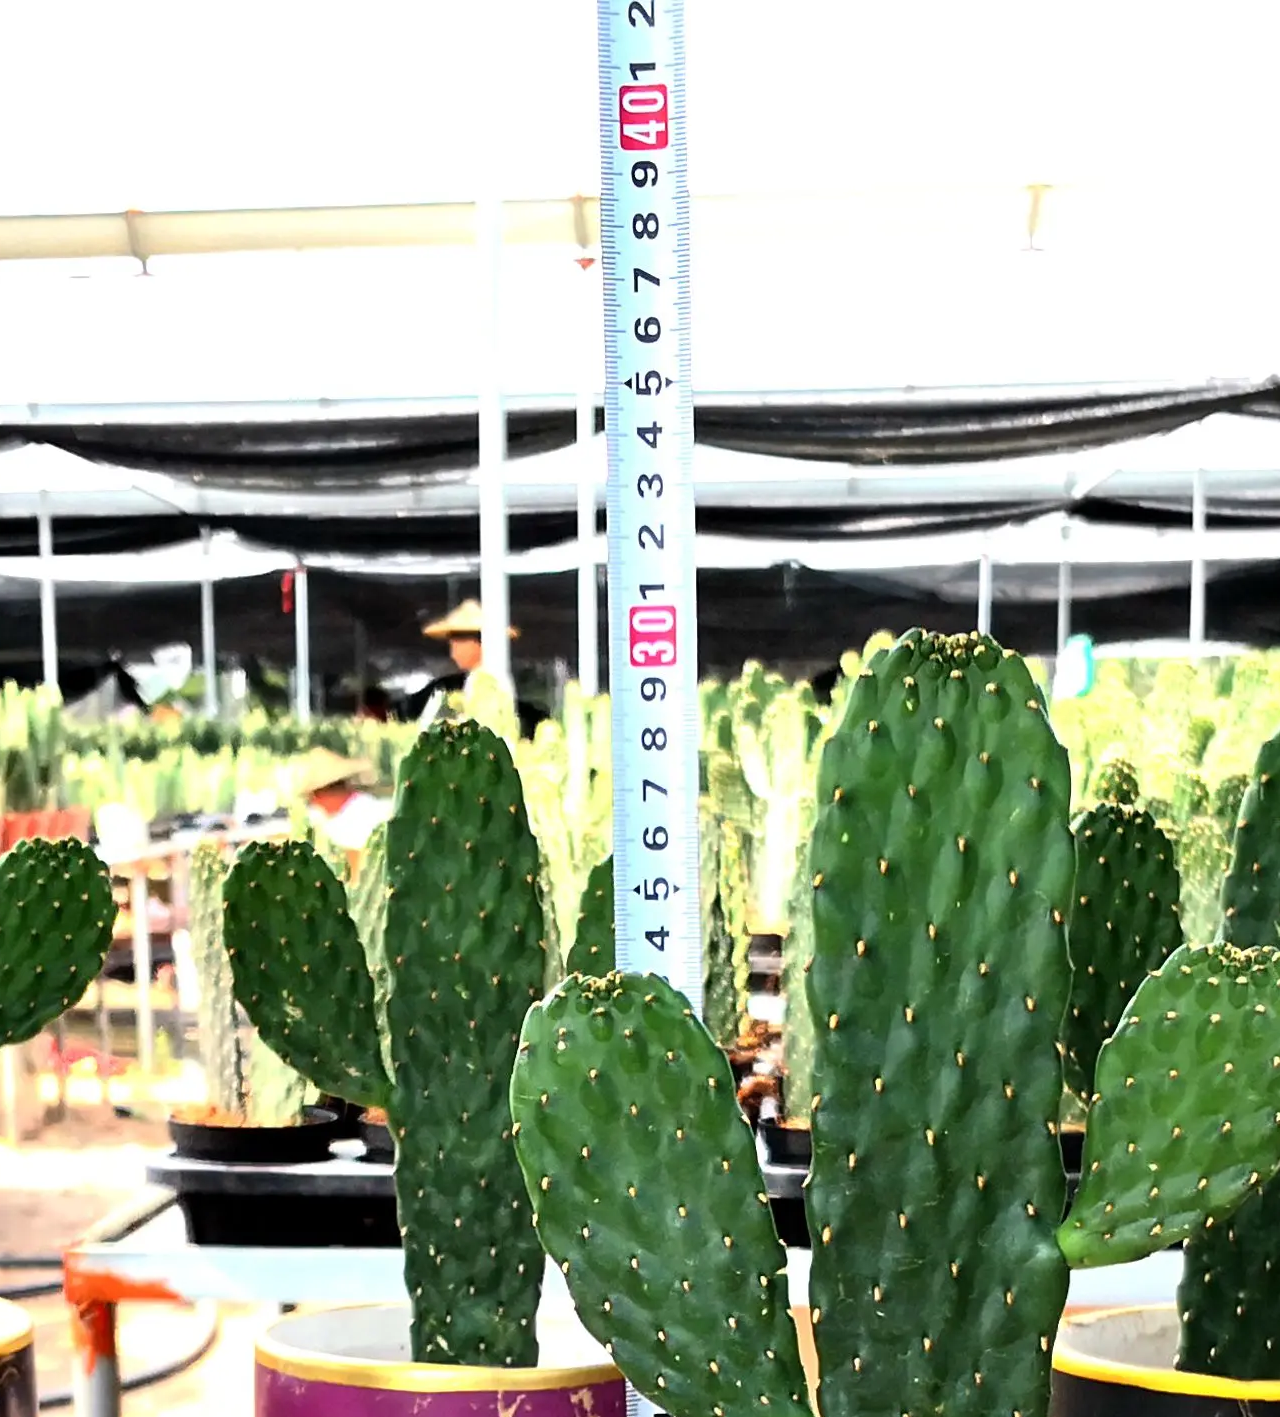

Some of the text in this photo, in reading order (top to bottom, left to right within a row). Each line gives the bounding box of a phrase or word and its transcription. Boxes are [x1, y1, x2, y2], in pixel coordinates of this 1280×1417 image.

[629, 62, 656, 81] 1
[622, 90, 666, 145] 40
[631, 160, 658, 188] 9
[632, 212, 659, 240] 8
[633, 267, 661, 293] 7
[634, 316, 662, 343] 6
[635, 370, 662, 396] 5
[637, 421, 663, 448] 4
[637, 473, 663, 498] 3
[638, 524, 664, 550] 2
[639, 584, 665, 600] 1
[632, 610, 674, 664] 30
[640, 677, 666, 701] 9
[641, 727, 667, 751] 8
[643, 779, 668, 802] 7
[643, 826, 669, 850] 6
[644, 877, 669, 900] 5
[645, 926, 670, 951] 4
